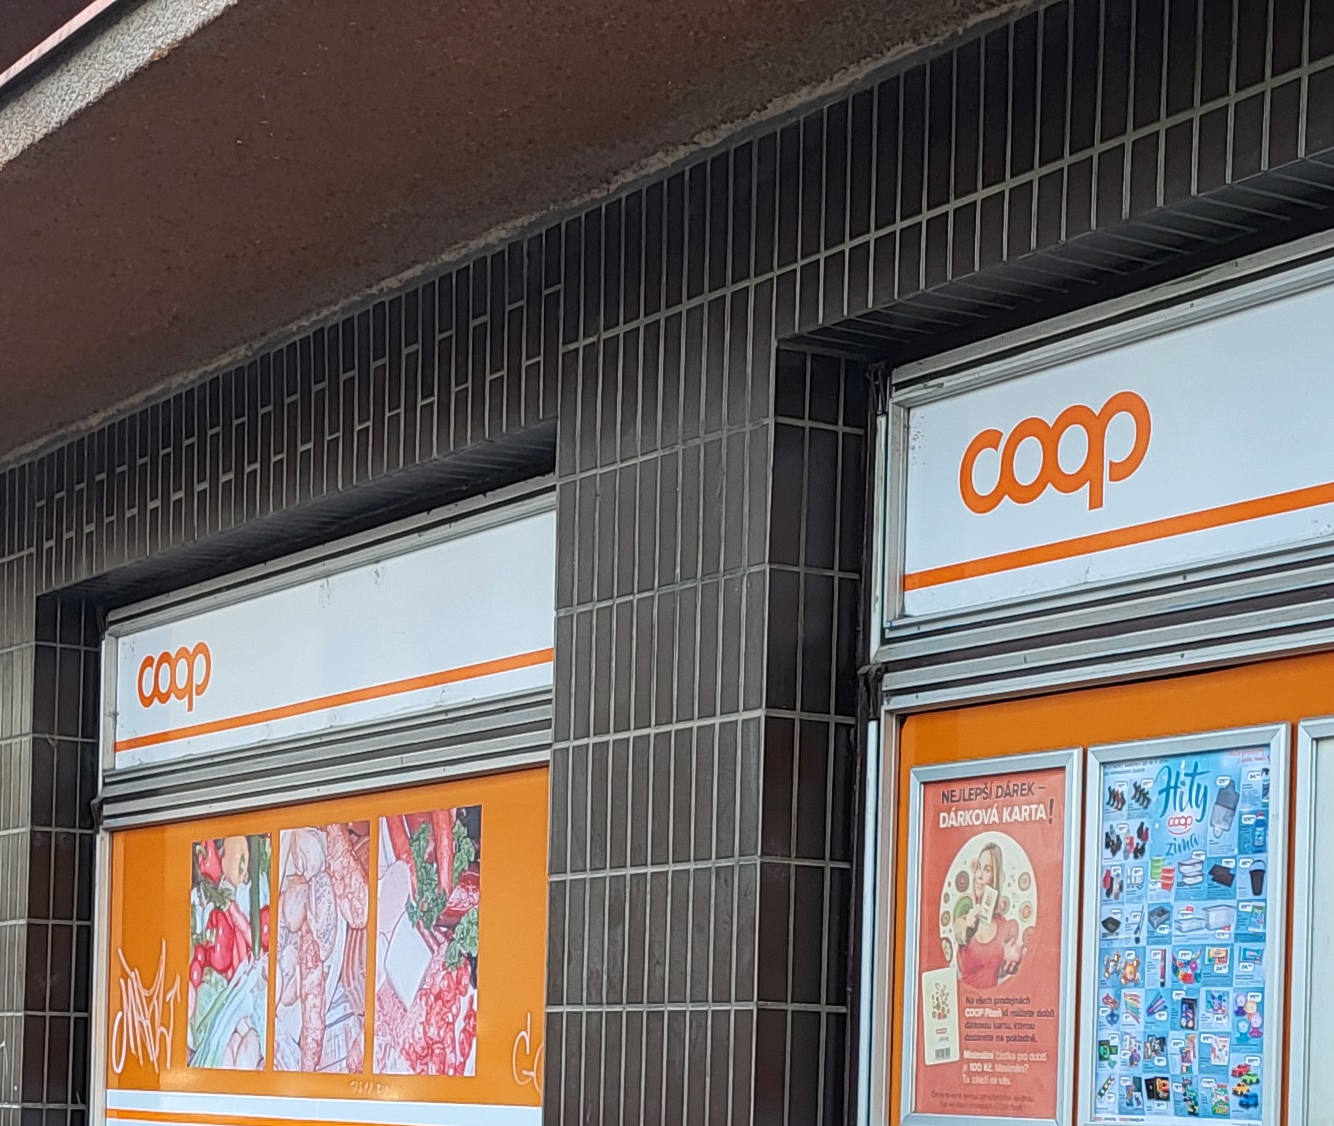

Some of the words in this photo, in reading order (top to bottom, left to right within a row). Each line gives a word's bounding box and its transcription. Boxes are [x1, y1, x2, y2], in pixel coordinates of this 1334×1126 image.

[958, 390, 1152, 513] coop
[138, 641, 212, 713] coop
[939, 803, 1000, 828] DÁRKOVÁ
[1002, 798, 1055, 824] KARTA!
[941, 781, 993, 804] NEJLEPŠÍ
[995, 780, 1036, 799] DÁREK
[1155, 761, 1211, 822] Hity
[1165, 832, 1200, 857] zima
